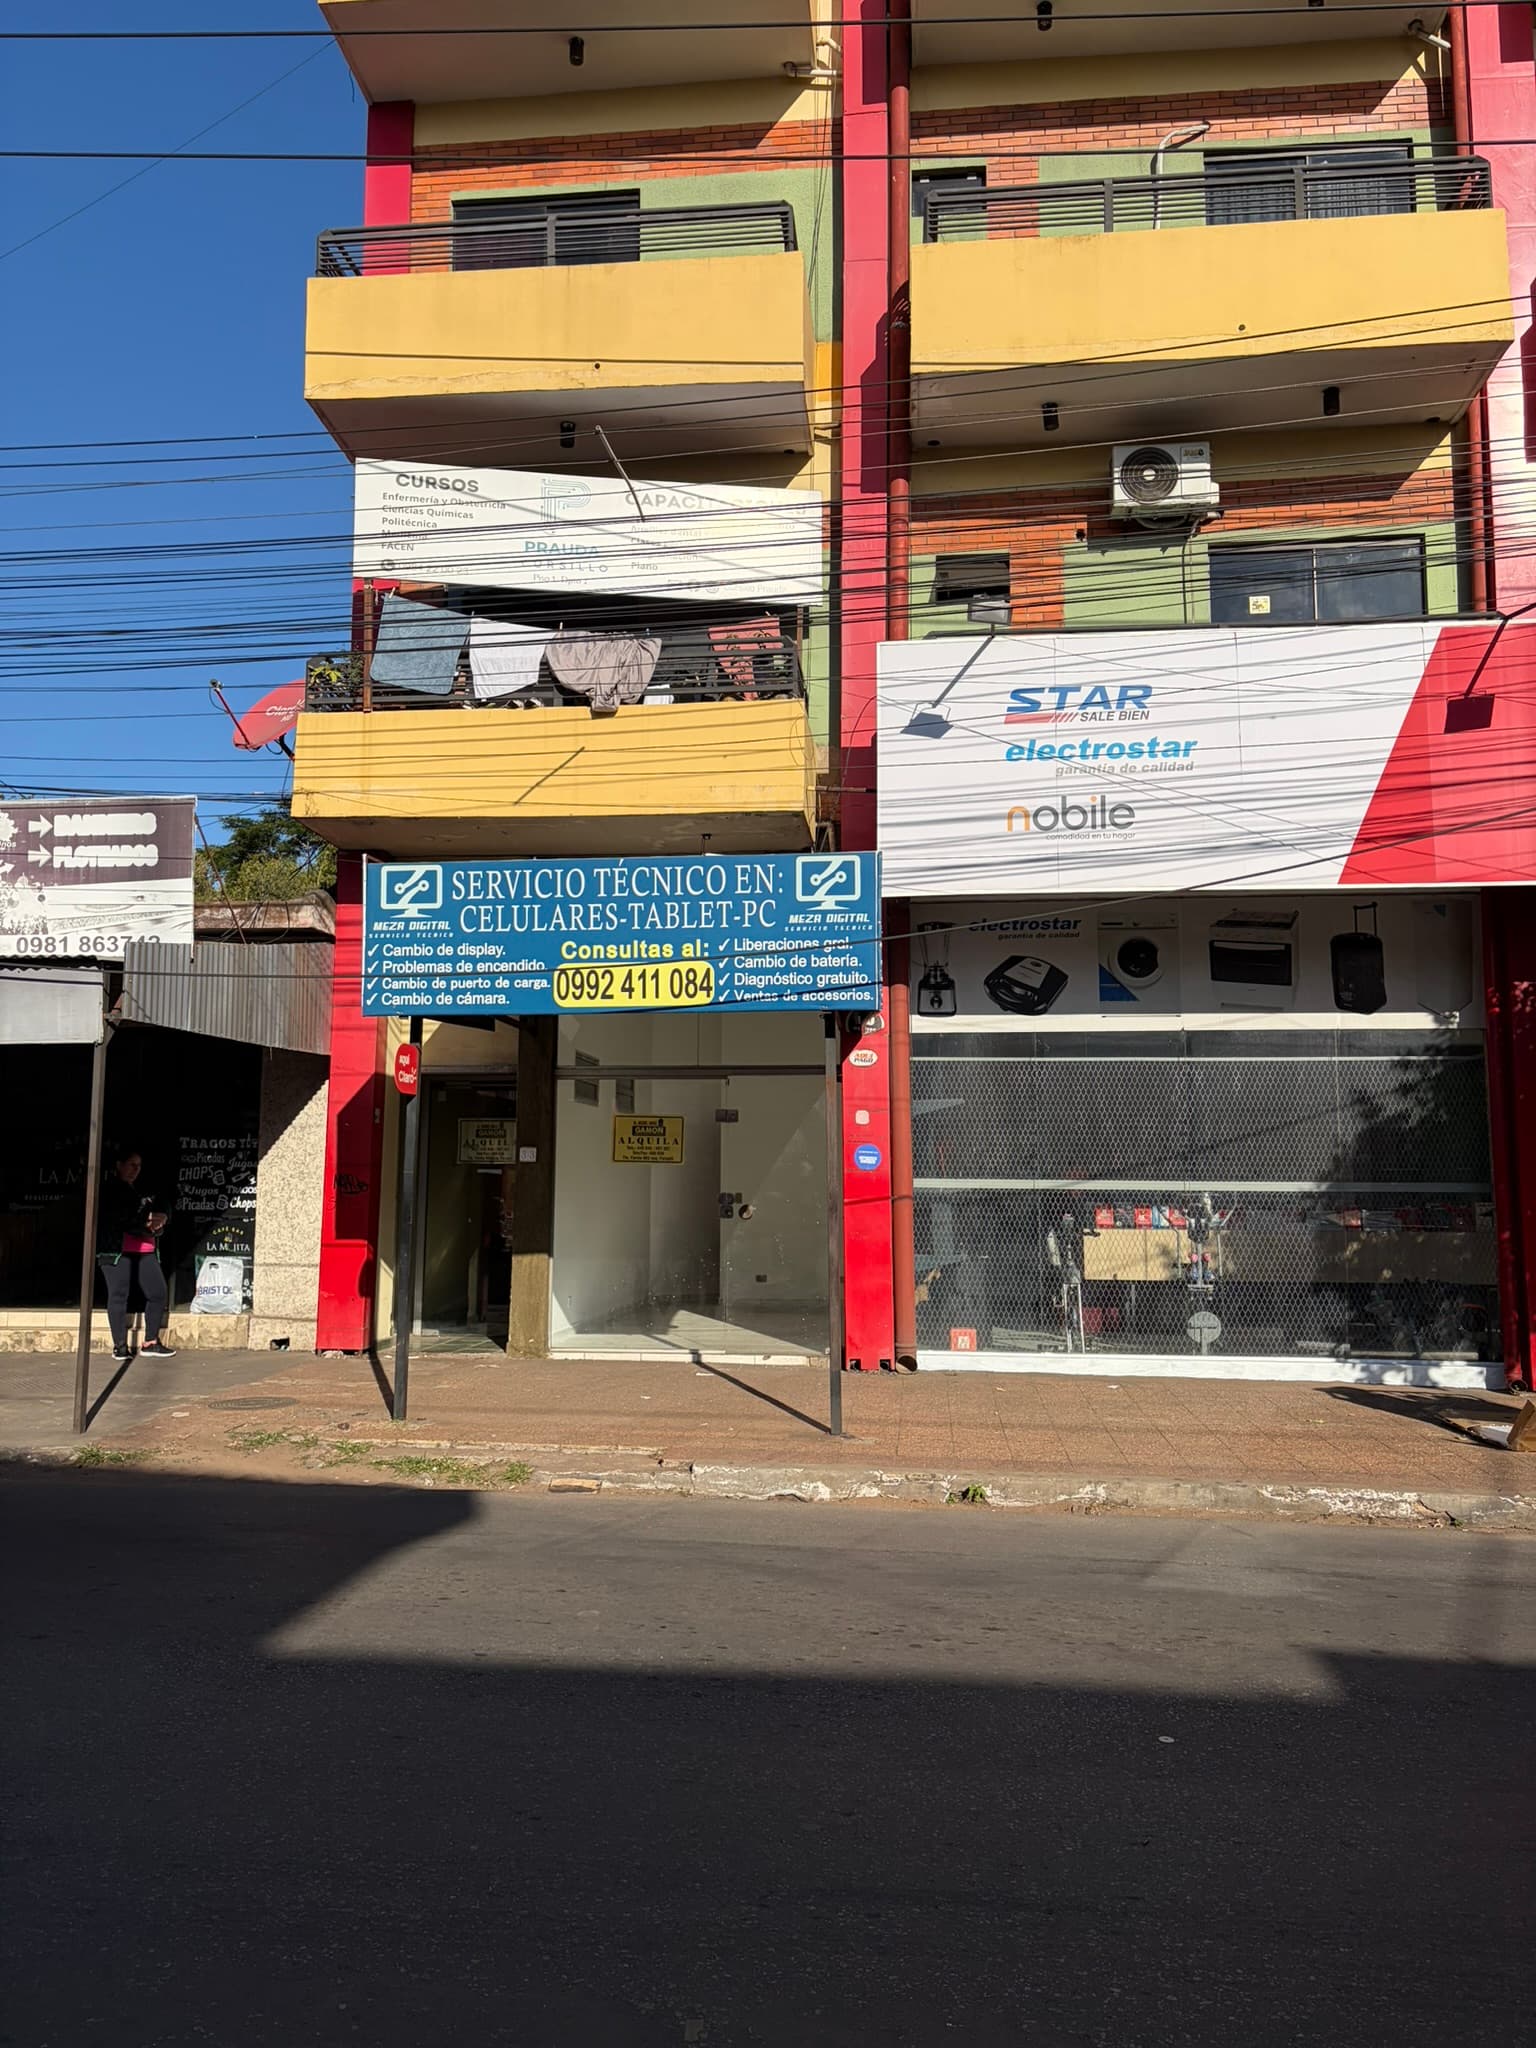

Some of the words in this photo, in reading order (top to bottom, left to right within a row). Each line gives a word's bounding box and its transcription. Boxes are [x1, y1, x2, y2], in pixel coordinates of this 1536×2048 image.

[396, 473, 479, 493] CURSOS
[382, 492, 439, 505] Enfermería
[441, 498, 448, 506] y
[382, 504, 424, 515] Ciencias
[426, 507, 474, 519] Químicas
[382, 516, 438, 528] Politécnica
[521, 560, 608, 572] URSILLO
[1006, 684, 1153, 713] STAR
[1079, 711, 1115, 722] SALE
[1118, 710, 1150, 721] BIEN
[1005, 736, 1198, 762] electrostar
[1120, 762, 1137, 773] de
[1141, 761, 1195, 773] calidad
[1006, 795, 1136, 833] nobile
[1112, 832, 1136, 840] hogar
[452, 868, 586, 900] SERVICIO
[593, 858, 727, 897] TÉCNICO
[734, 864, 784, 895] EN:
[459, 900, 777, 934] CELULARES-TABLET-PC
[788, 914, 822, 924] MEZA
[826, 913, 870, 923] DIGITAL
[968, 916, 1082, 932] electrostar
[373, 921, 406, 931] MEZA
[409, 920, 452, 930] DIGITAL
[1048, 931, 1080, 939] calidad
[16, 936, 70, 954] 0981
[382, 943, 434, 956] Cambio
[436, 943, 454, 956] de
[457, 944, 506, 958] display.
[560, 940, 674, 960] Consultas
[682, 938, 710, 958] al:
[734, 938, 820, 951] Liberaciones
[823, 936, 854, 952] gral.
[382, 960, 451, 974] Problemas
[456, 960, 473, 972] de
[476, 960, 548, 972] encendido.
[734, 954, 786, 968] Cambio
[790, 955, 808, 968] de
[811, 954, 863, 967] batería.
[382, 977, 428, 990] Cambio
[432, 977, 447, 988] de
[450, 978, 491, 990] puerto
[494, 976, 510, 988] de
[514, 978, 551, 990] carga.
[556, 968, 615, 1000] 0992
[620, 968, 660, 1000] 411
[670, 968, 713, 999] 084
[734, 972, 813, 988] Diagnóstico
[816, 972, 872, 988] gratuito.
[381, 993, 433, 1006] Cambio
[436, 992, 453, 1005] de
[456, 993, 510, 1005] cámara.
[734, 989, 778, 1002] Ventas
[782, 988, 799, 1001] de
[802, 988, 874, 1002] accesorios.
[179, 1136, 237, 1149] TRAGOS
[618, 1136, 680, 1146] ALQUILA
[179, 1165, 214, 1181] CHOPS
[206, 1242, 217, 1252] LA
